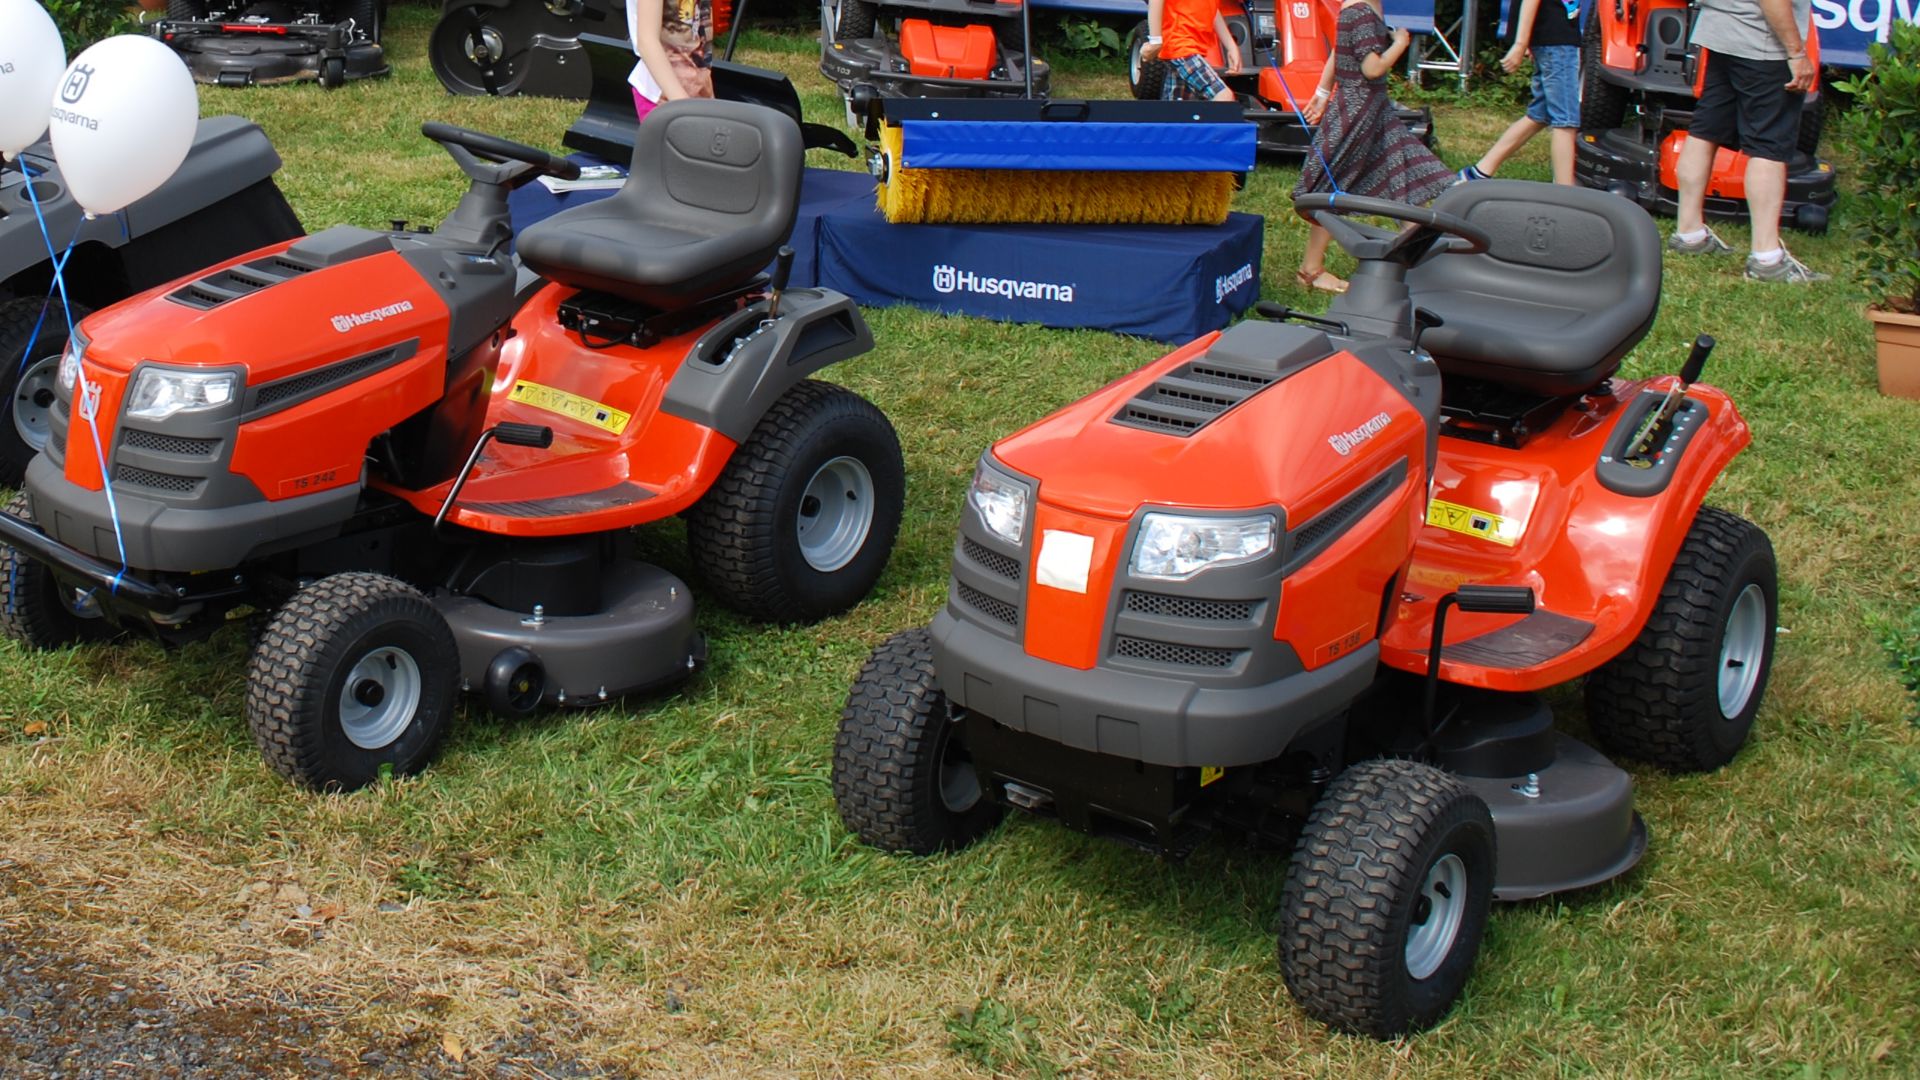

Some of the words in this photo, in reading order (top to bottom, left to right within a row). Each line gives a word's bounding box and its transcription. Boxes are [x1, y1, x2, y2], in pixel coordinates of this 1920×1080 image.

[957, 270, 1073, 302] Husqvarna
[345, 300, 414, 328] Husqvarna
[1339, 411, 1392, 449] Husqvarna
[295, 477, 310, 489] TS
[313, 470, 337, 487] 242
[1328, 642, 1340, 657] TS
